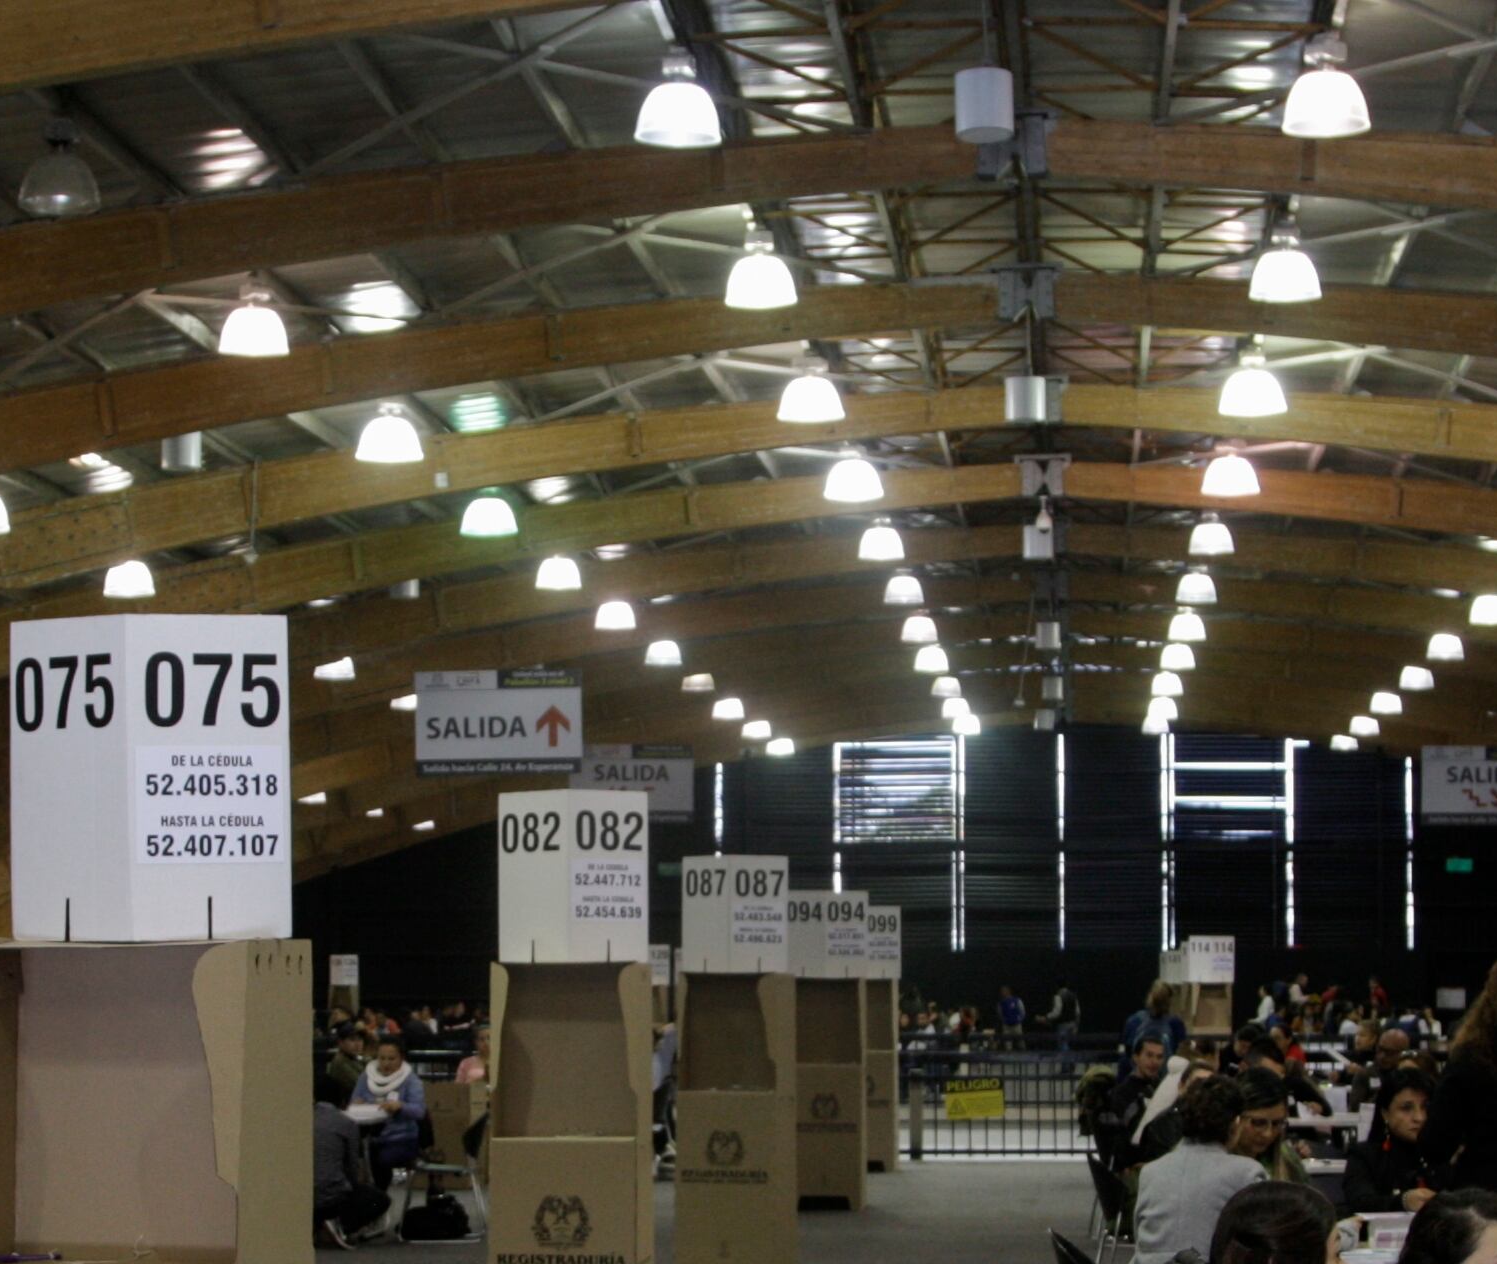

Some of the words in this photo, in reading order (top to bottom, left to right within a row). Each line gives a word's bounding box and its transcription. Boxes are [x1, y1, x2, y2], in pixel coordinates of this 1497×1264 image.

[14, 652, 115, 733] 075
[144, 650, 281, 728] 075
[426, 715, 527, 740] SALIDA
[171, 755, 187, 767] DE
[190, 755, 205, 767] LA
[207, 753, 253, 767] CÉDULA
[593, 763, 670, 782] SALIDA
[145, 773, 278, 797] 52.405.318
[160, 815, 197, 827] HASTA
[201, 815, 216, 827] LA
[219, 813, 265, 828] CÉDULA
[576, 809, 644, 852] 082
[502, 811, 561, 854] 082
[146, 834, 279, 857] 52.407.107
[574, 873, 641, 887] 52.447.712
[685, 868, 727, 897] 087
[734, 869, 785, 897] 087
[575, 905, 643, 919] 52.454.639
[788, 901, 823, 922] 094
[827, 901, 865, 922] 094
[868, 915, 897, 933] 099
[1190, 941, 1211, 953] 114
[1214, 941, 1234, 953] 114
[946, 1077, 1000, 1092] PELIGRO
